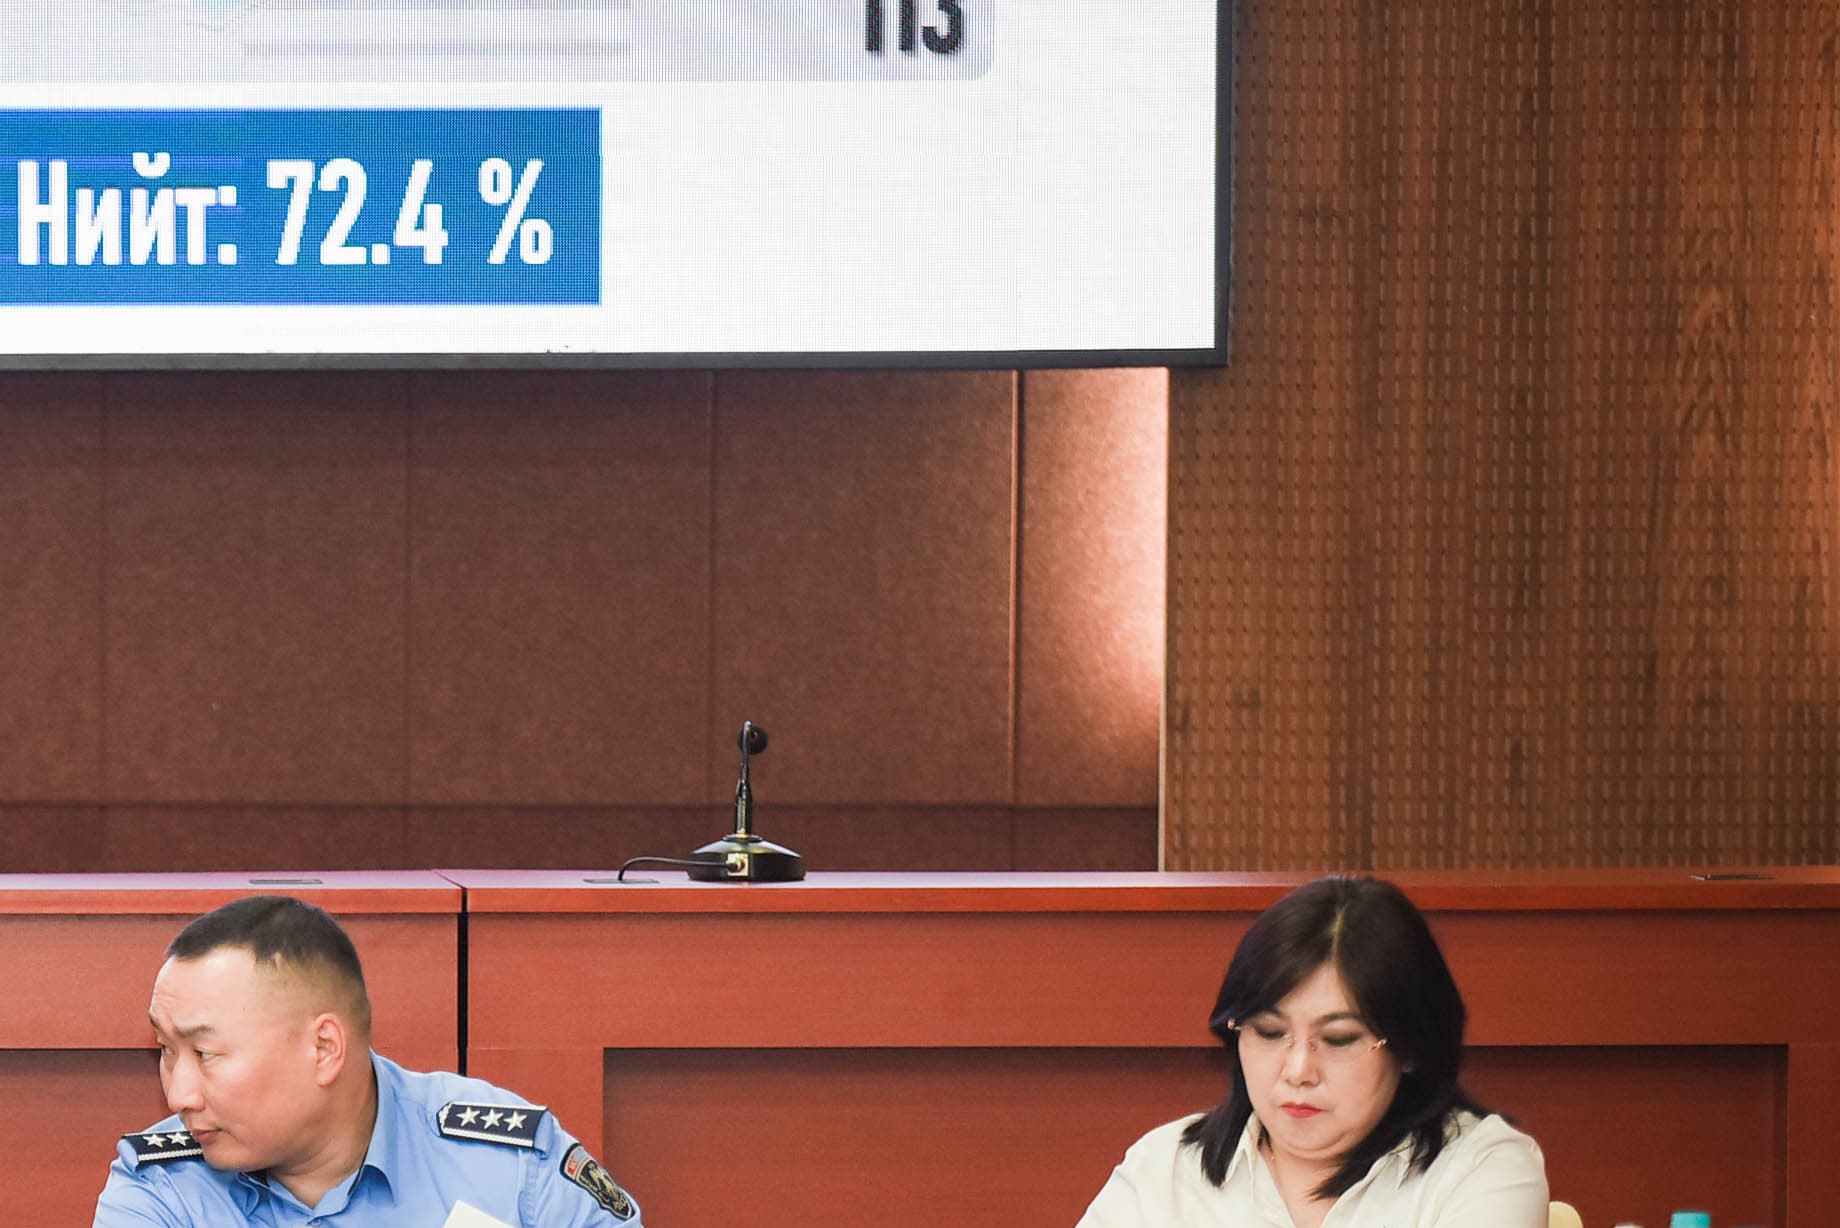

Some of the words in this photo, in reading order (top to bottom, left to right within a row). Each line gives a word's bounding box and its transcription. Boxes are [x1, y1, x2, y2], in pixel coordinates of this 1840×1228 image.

[16, 151, 238, 266] Нийт:
[265, 157, 449, 266] 72.4
[477, 157, 554, 266] %
